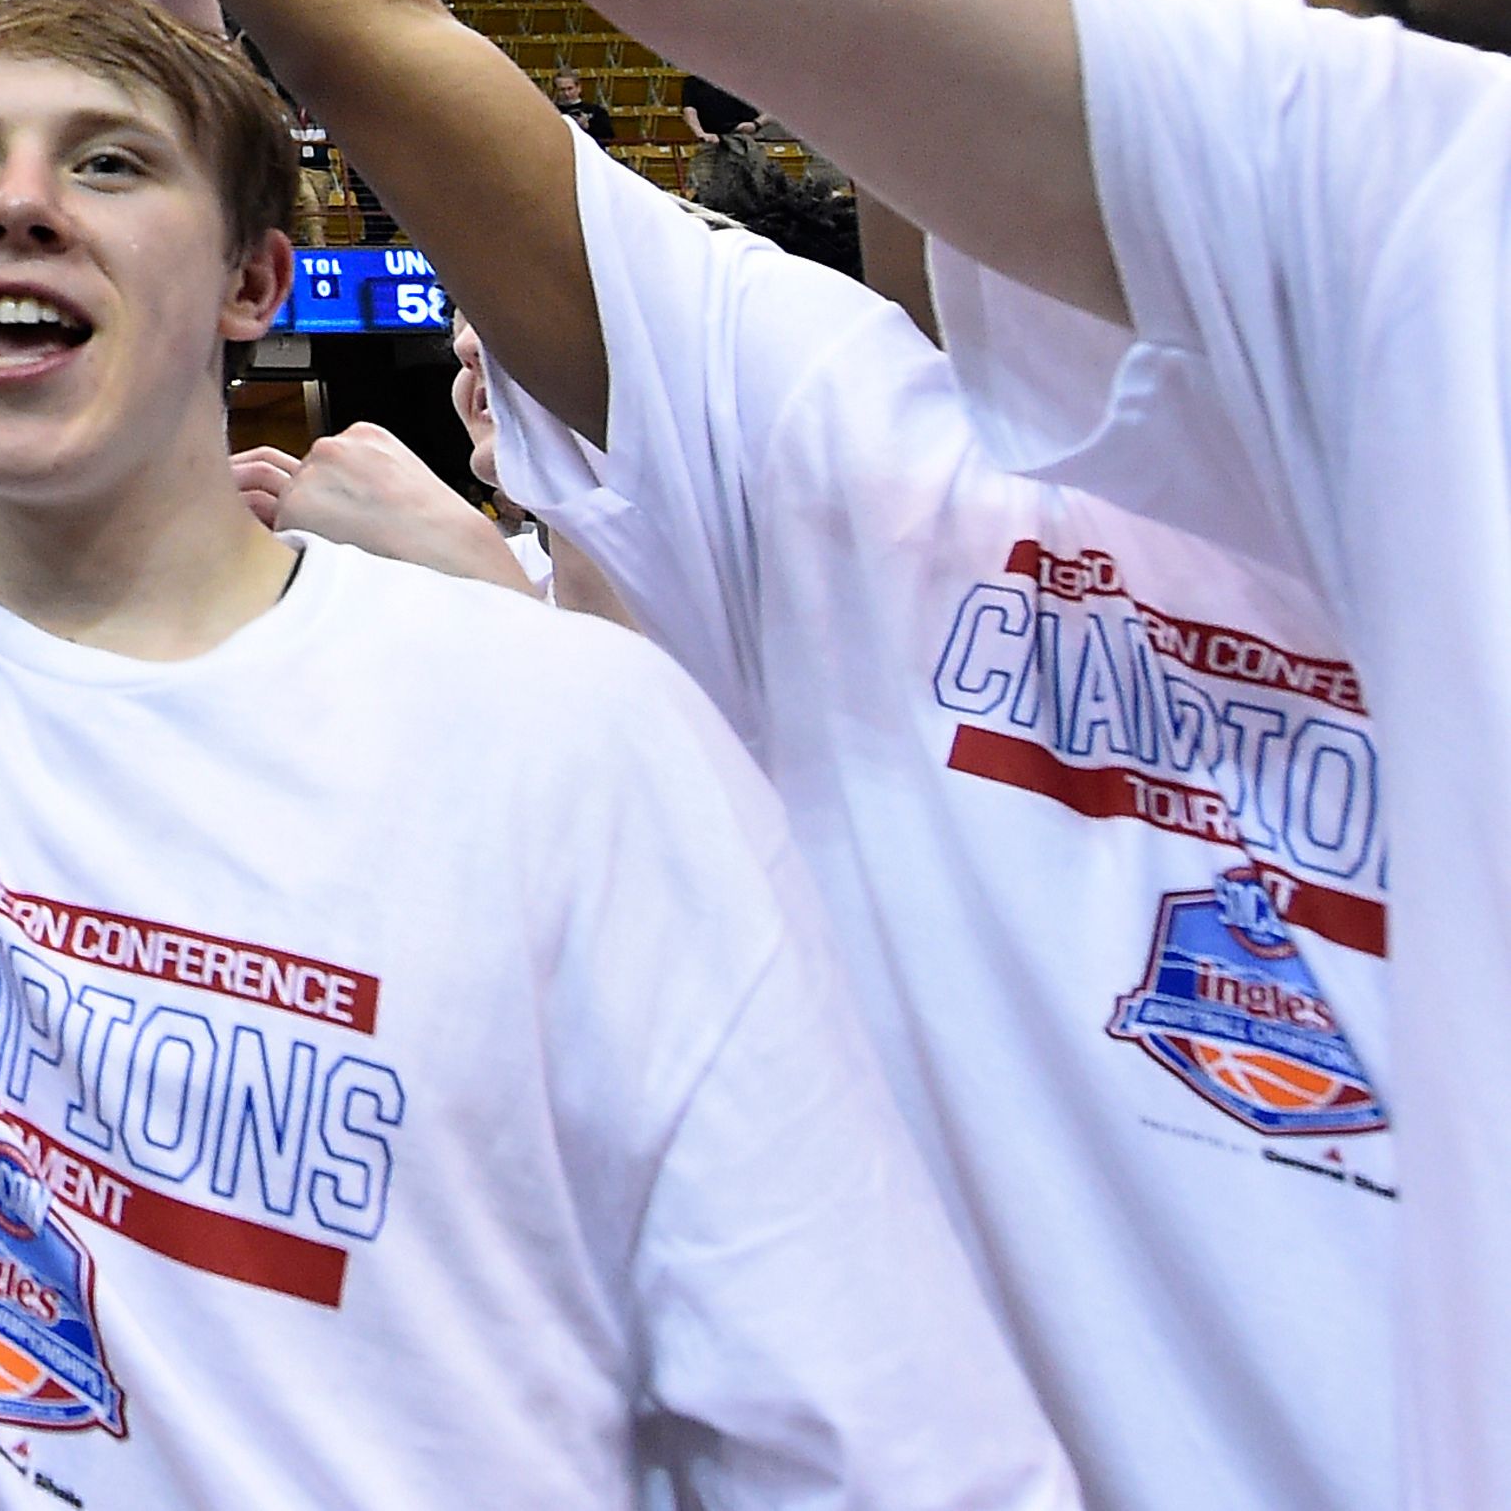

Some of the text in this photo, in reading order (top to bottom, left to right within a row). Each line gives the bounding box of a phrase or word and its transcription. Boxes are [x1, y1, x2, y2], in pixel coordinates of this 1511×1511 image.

[302, 258, 342, 275] TOL
[316, 280, 332, 298] 0
[74, 918, 358, 1024] CONFERENCE
